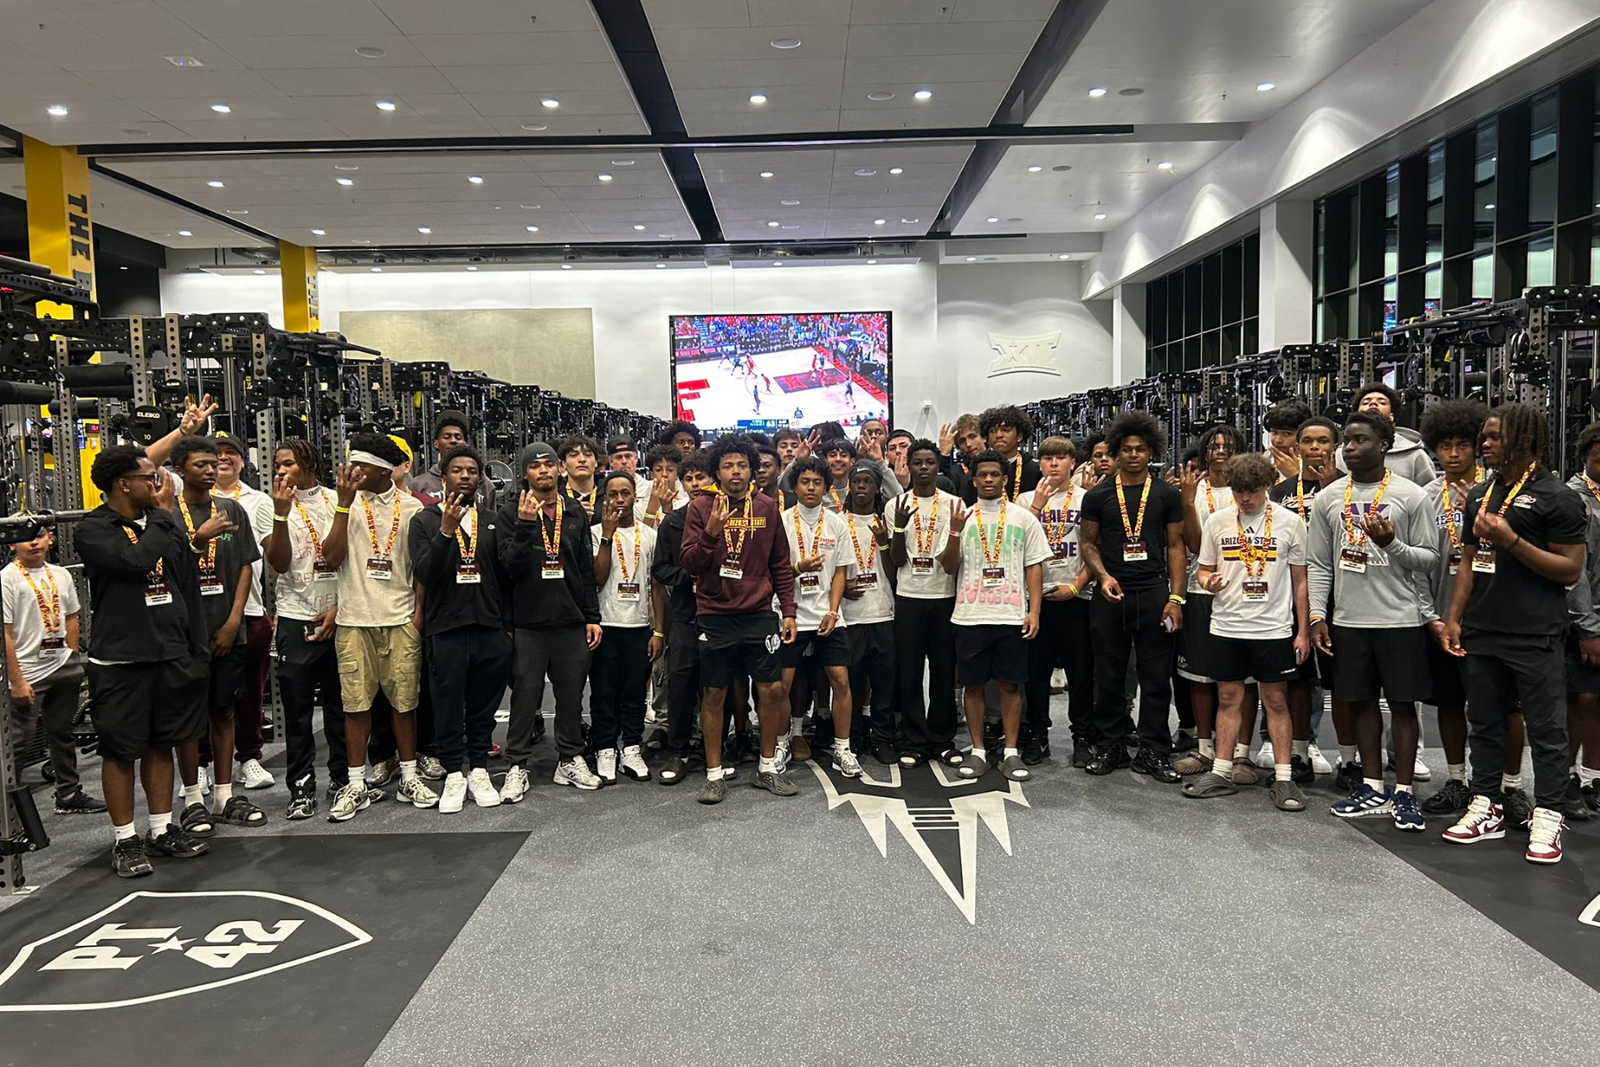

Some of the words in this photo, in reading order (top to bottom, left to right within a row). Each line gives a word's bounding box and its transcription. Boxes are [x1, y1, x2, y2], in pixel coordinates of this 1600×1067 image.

[68, 193, 91, 261] THE
[136, 411, 161, 419] ELEIKO
[1221, 536, 1253, 546] ARIZOA
[1254, 536, 1277, 546] STTE
[37, 922, 183, 972] PT
[184, 919, 306, 969] 42
